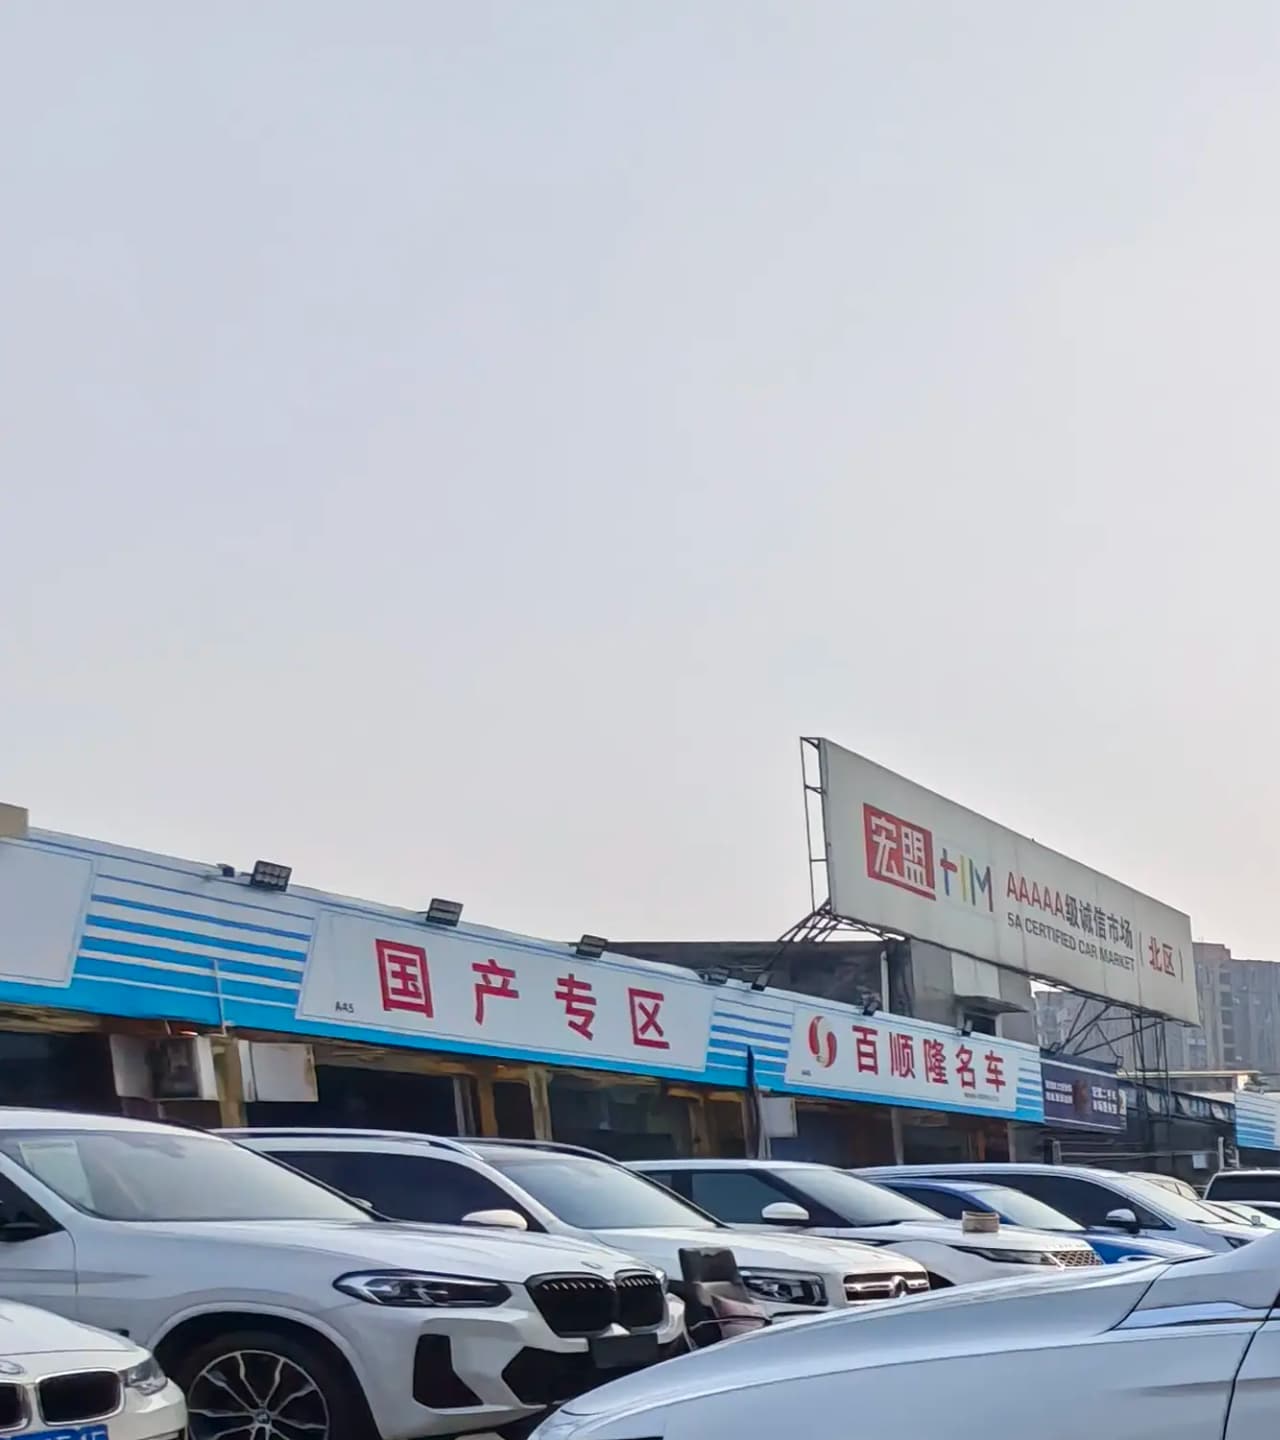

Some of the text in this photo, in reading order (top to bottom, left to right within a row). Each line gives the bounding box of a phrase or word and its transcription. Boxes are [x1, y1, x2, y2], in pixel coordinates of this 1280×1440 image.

[870, 815, 930, 888] 宏盟
[1024, 917, 1077, 951] CERTIFIED
[1078, 939, 1098, 960] CAR
[1099, 946, 1135, 972] MARKET
[374, 937, 672, 1050] 国产专区
[852, 1024, 1007, 1094] 百顺隆名车
